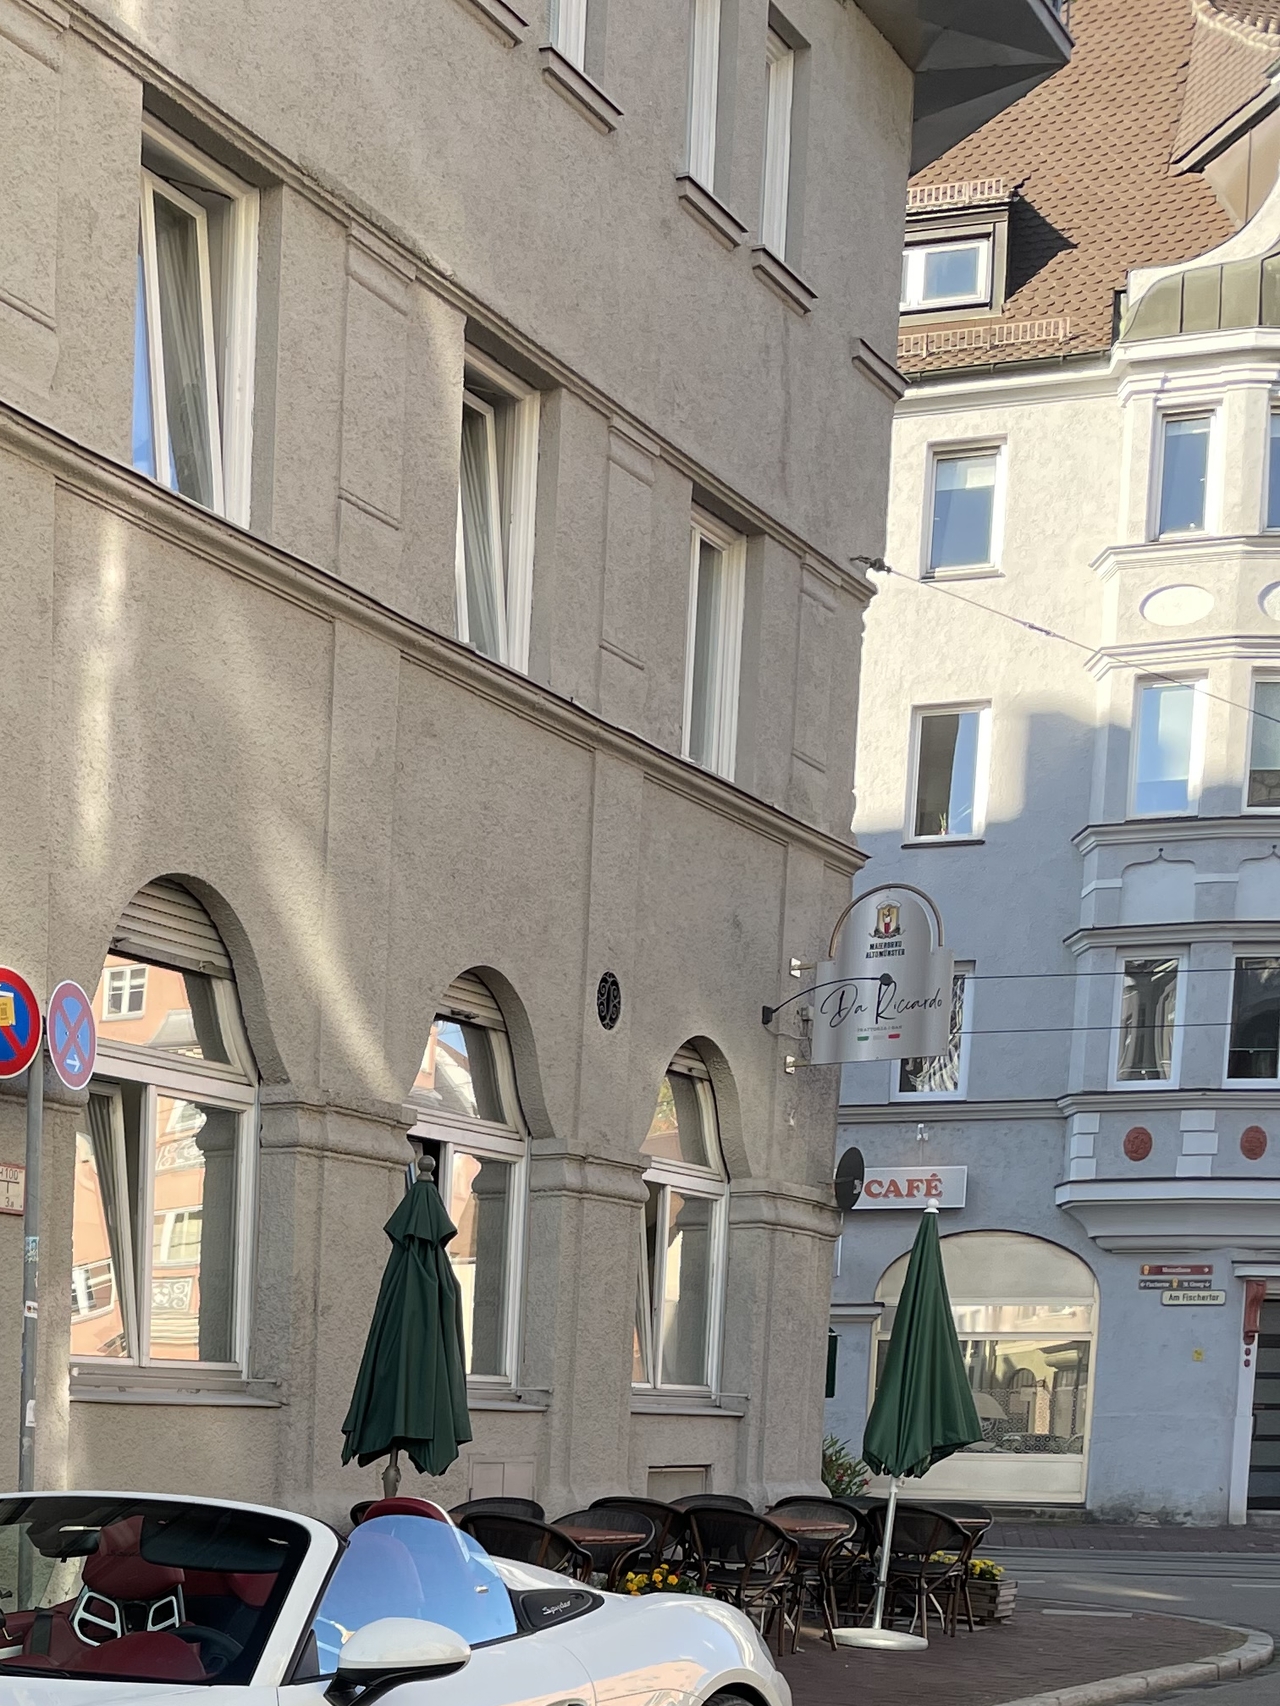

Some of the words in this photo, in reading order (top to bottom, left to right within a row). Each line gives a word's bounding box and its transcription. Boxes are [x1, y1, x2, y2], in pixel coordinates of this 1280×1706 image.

[820, 984, 868, 1028] Da
[864, 1173, 943, 1199] CAFÉ
[1168, 1293, 1180, 1301] Am
[1182, 1293, 1219, 1302] Fischertor
